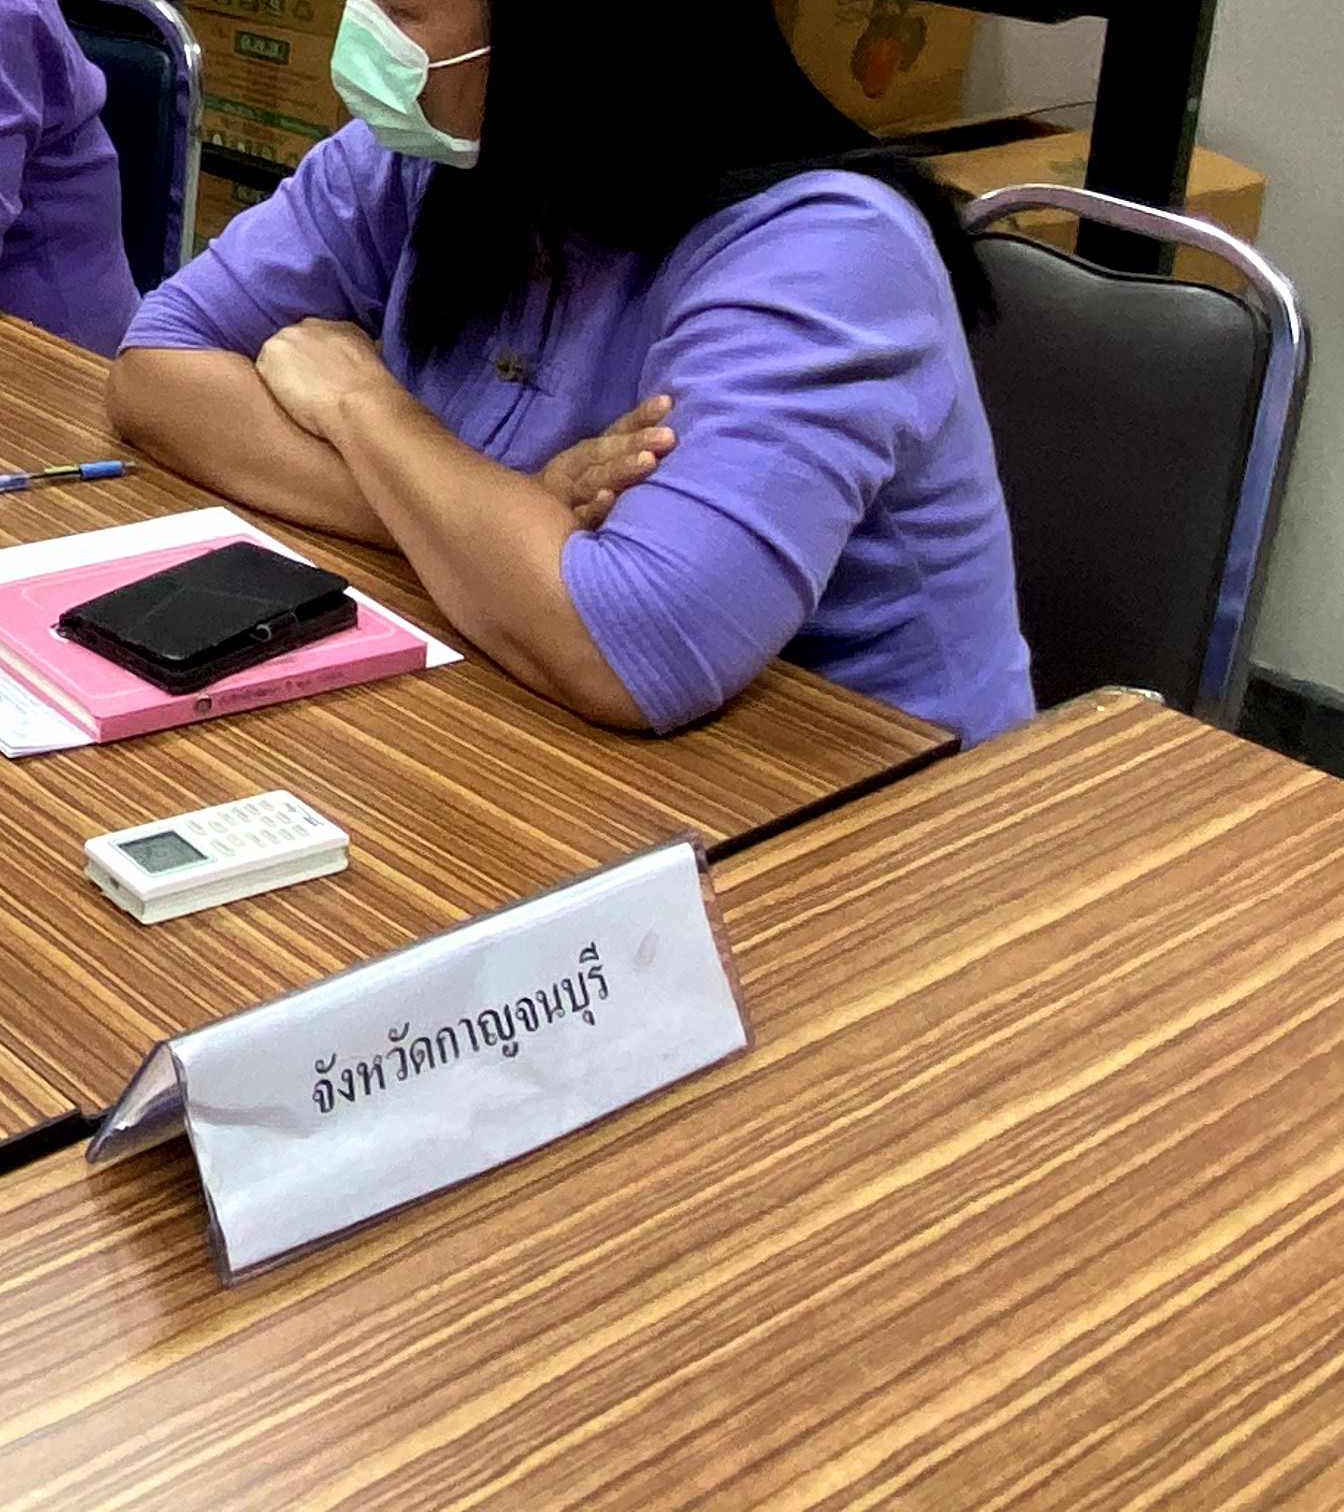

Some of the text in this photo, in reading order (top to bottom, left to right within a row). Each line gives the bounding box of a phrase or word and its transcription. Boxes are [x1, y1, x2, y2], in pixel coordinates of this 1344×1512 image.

[312, 942, 609, 1113] จังหวัดกาญจนบุรี
